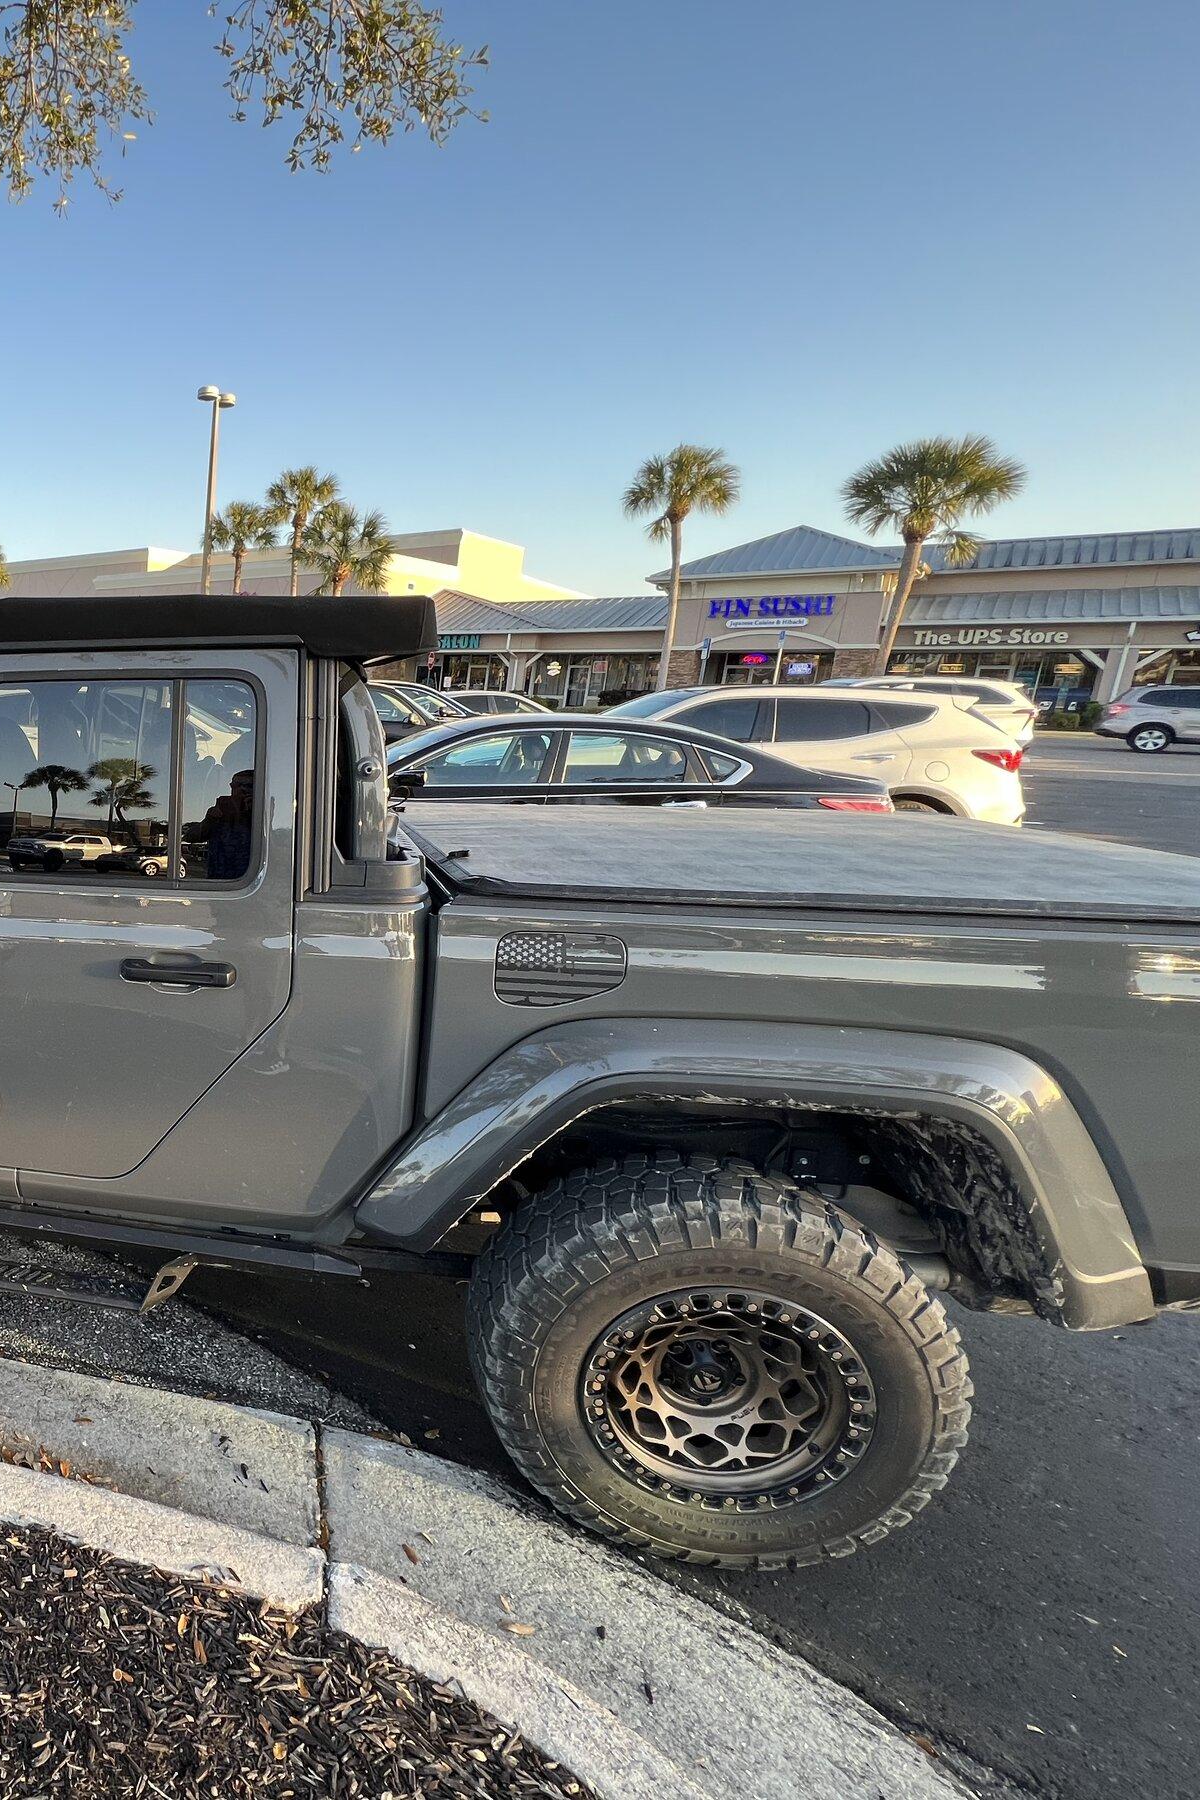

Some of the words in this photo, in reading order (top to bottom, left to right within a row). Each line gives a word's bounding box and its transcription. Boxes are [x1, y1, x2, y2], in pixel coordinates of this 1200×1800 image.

[758, 595, 836, 616] SUSHI
[914, 630, 951, 645] The
[957, 629, 1003, 645] UPS
[1007, 628, 1069, 644] Store
[743, 655, 765, 665] OPEN
[730, 1406, 755, 1421] FUEL
